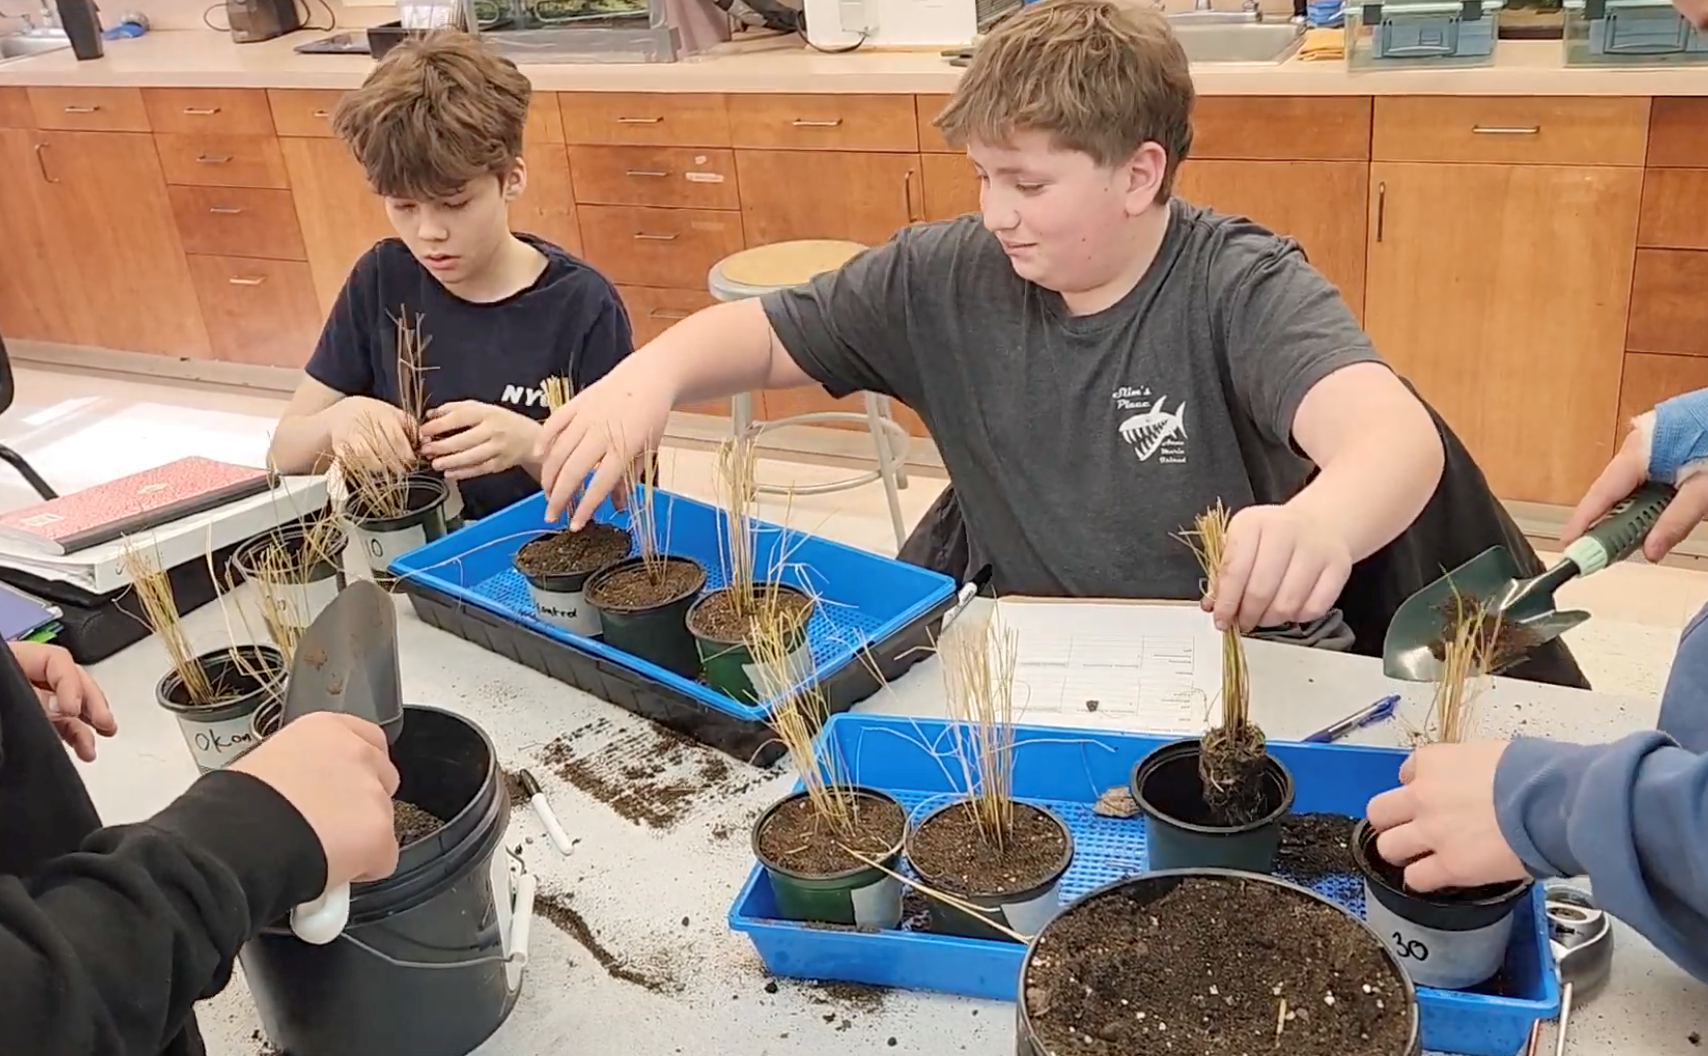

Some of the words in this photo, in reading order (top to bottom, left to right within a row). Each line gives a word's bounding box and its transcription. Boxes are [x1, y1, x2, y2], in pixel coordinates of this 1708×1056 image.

[1112, 385, 1151, 398] Slim's
[1117, 399, 1151, 409] Place
[1392, 931, 1429, 961] 30
